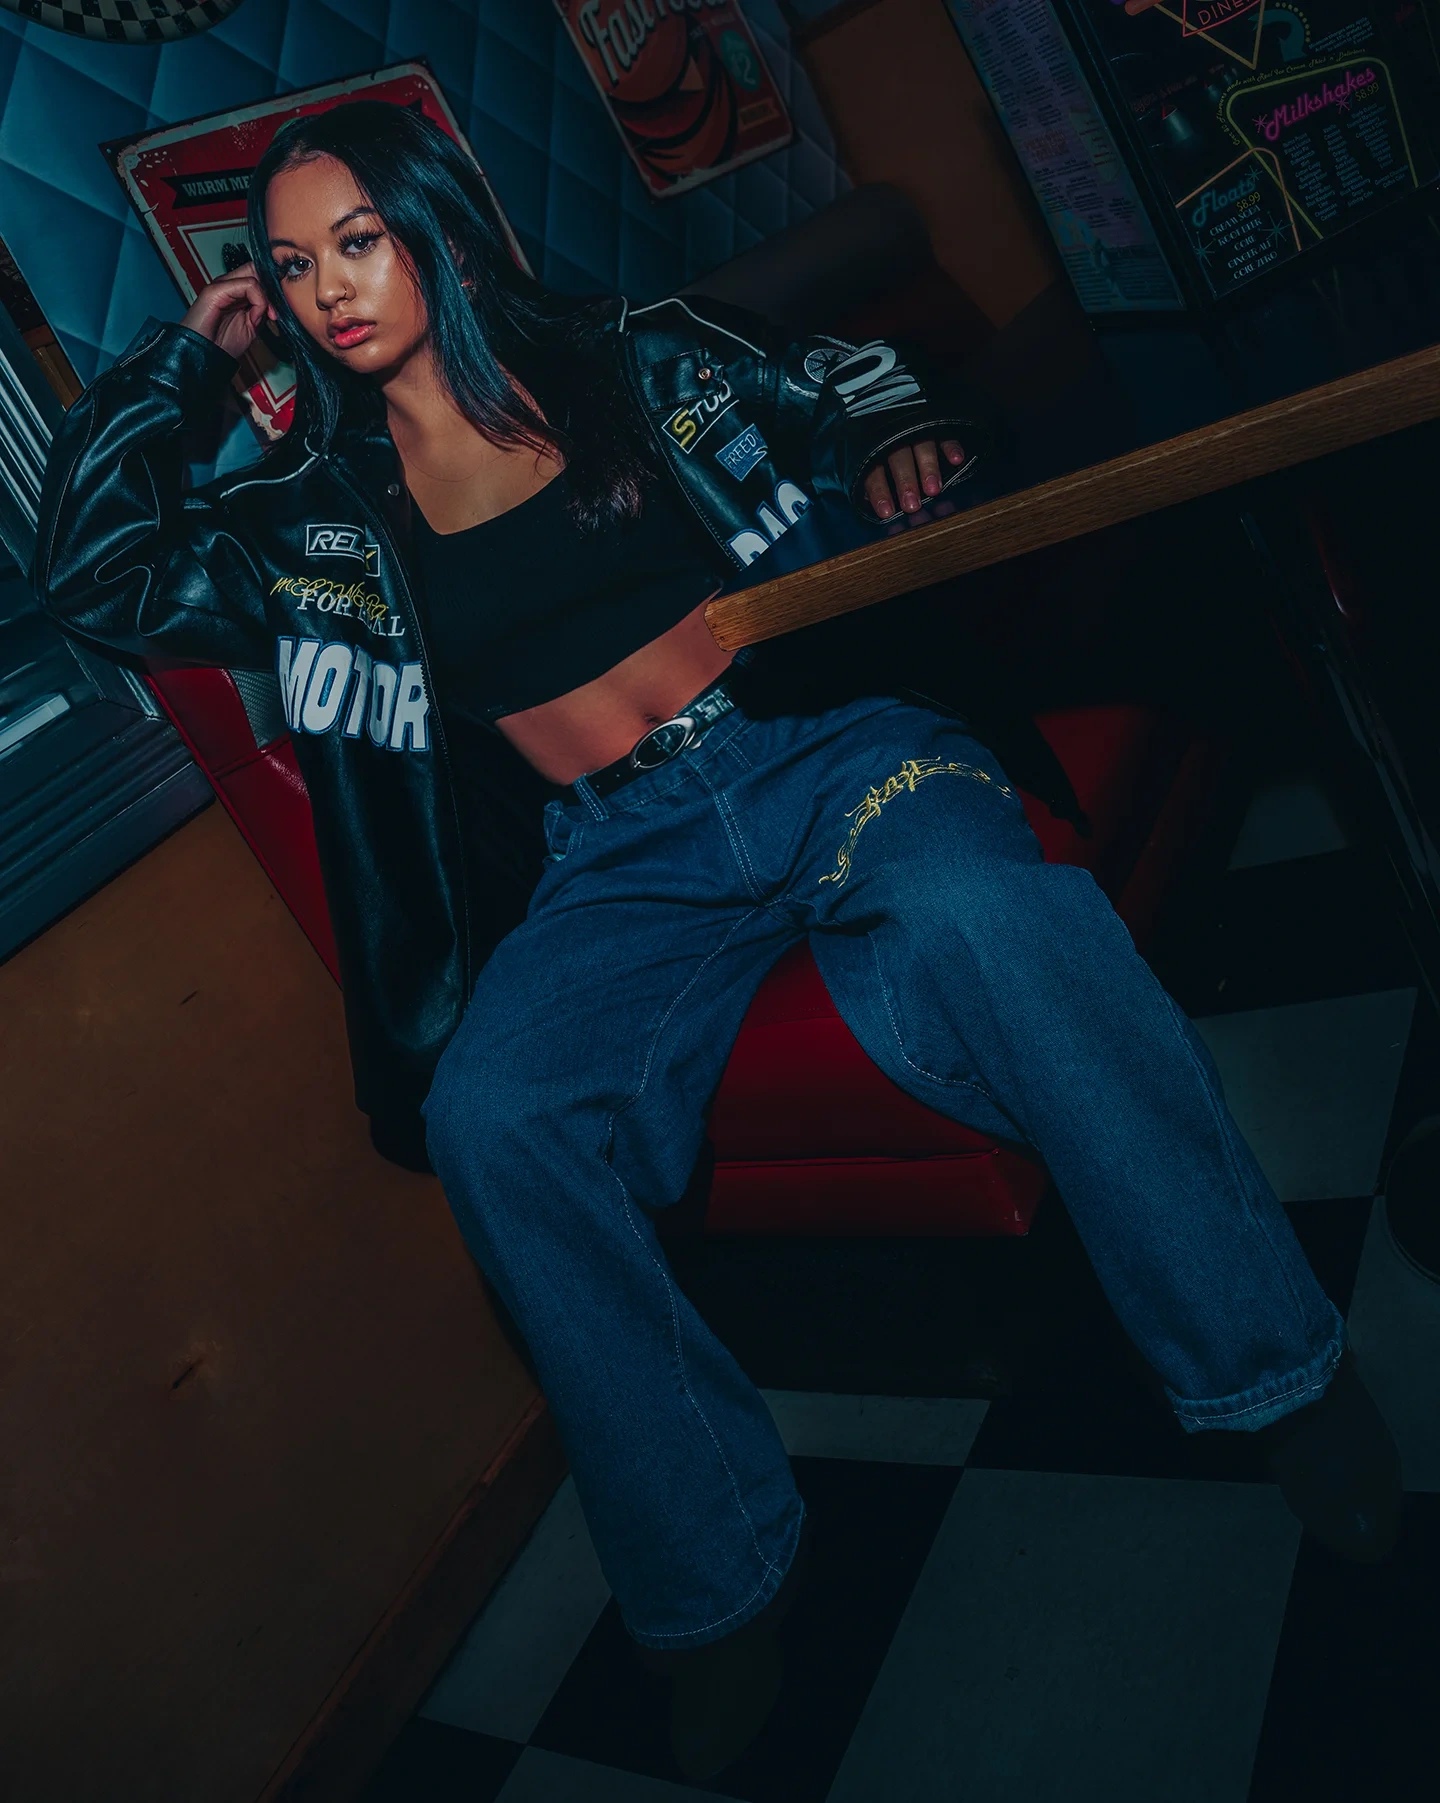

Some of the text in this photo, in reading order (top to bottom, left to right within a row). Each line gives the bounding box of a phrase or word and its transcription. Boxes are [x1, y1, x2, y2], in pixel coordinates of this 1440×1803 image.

[1198, 0, 1250, 26] DINE
[1264, 67, 1377, 142] Milkshakes
[1355, 82, 1380, 102] $8.99
[181, 174, 254, 197] WARM ME
[1191, 178, 1257, 228] Floats
[1236, 193, 1261, 213] $8.99
[1209, 205, 1262, 237] CREAM SODA
[1234, 234, 1258, 252] COKE
[1227, 246, 1257, 269] GINGER
[1233, 251, 1278, 280] COKE ZERO
[276, 634, 431, 753] MOTOR
